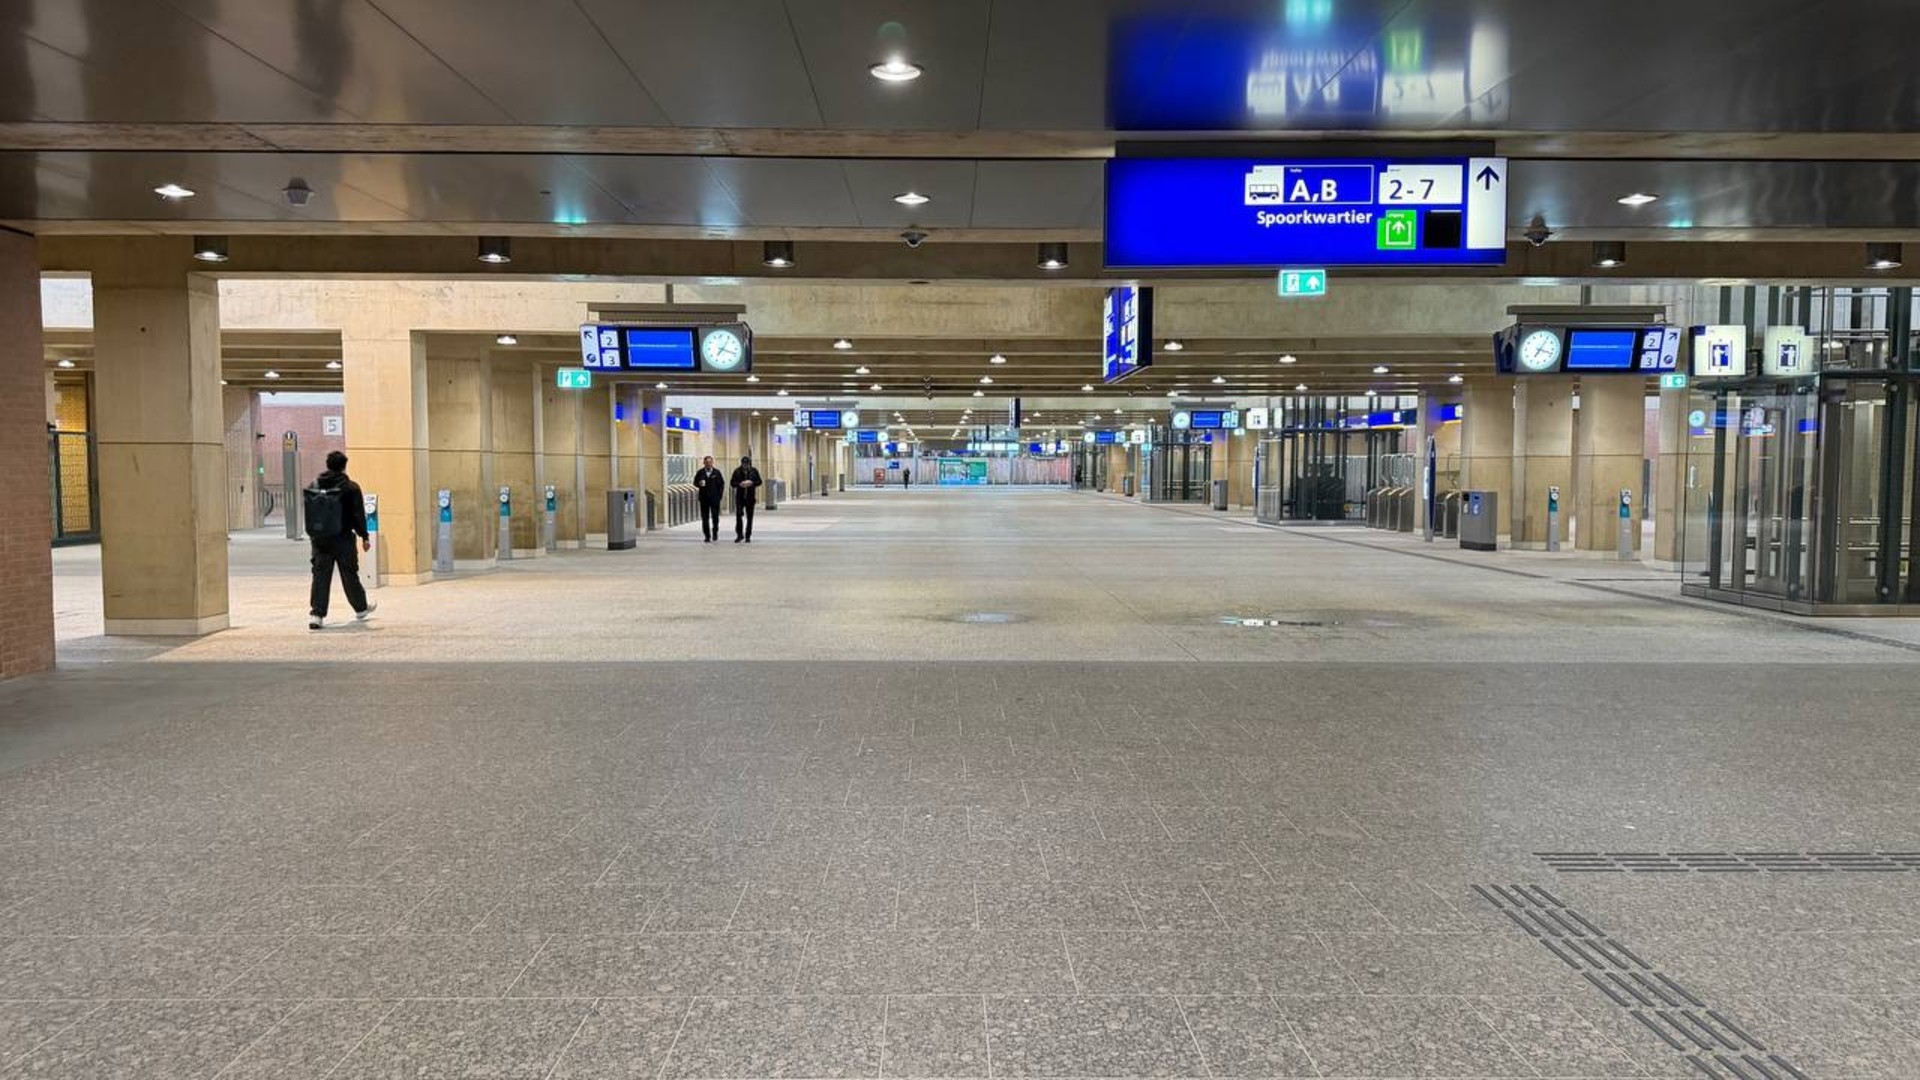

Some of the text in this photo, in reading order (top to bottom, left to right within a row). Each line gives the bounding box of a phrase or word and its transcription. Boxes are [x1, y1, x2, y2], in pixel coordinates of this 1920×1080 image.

[1290, 179, 1338, 202] A,B
[1257, 210, 1373, 228] Spoorkwartier
[606, 337, 613, 346] 2
[1648, 338, 1656, 347] 2
[609, 356, 616, 366] 3
[1646, 357, 1653, 366] 3
[328, 419, 337, 432] 5
